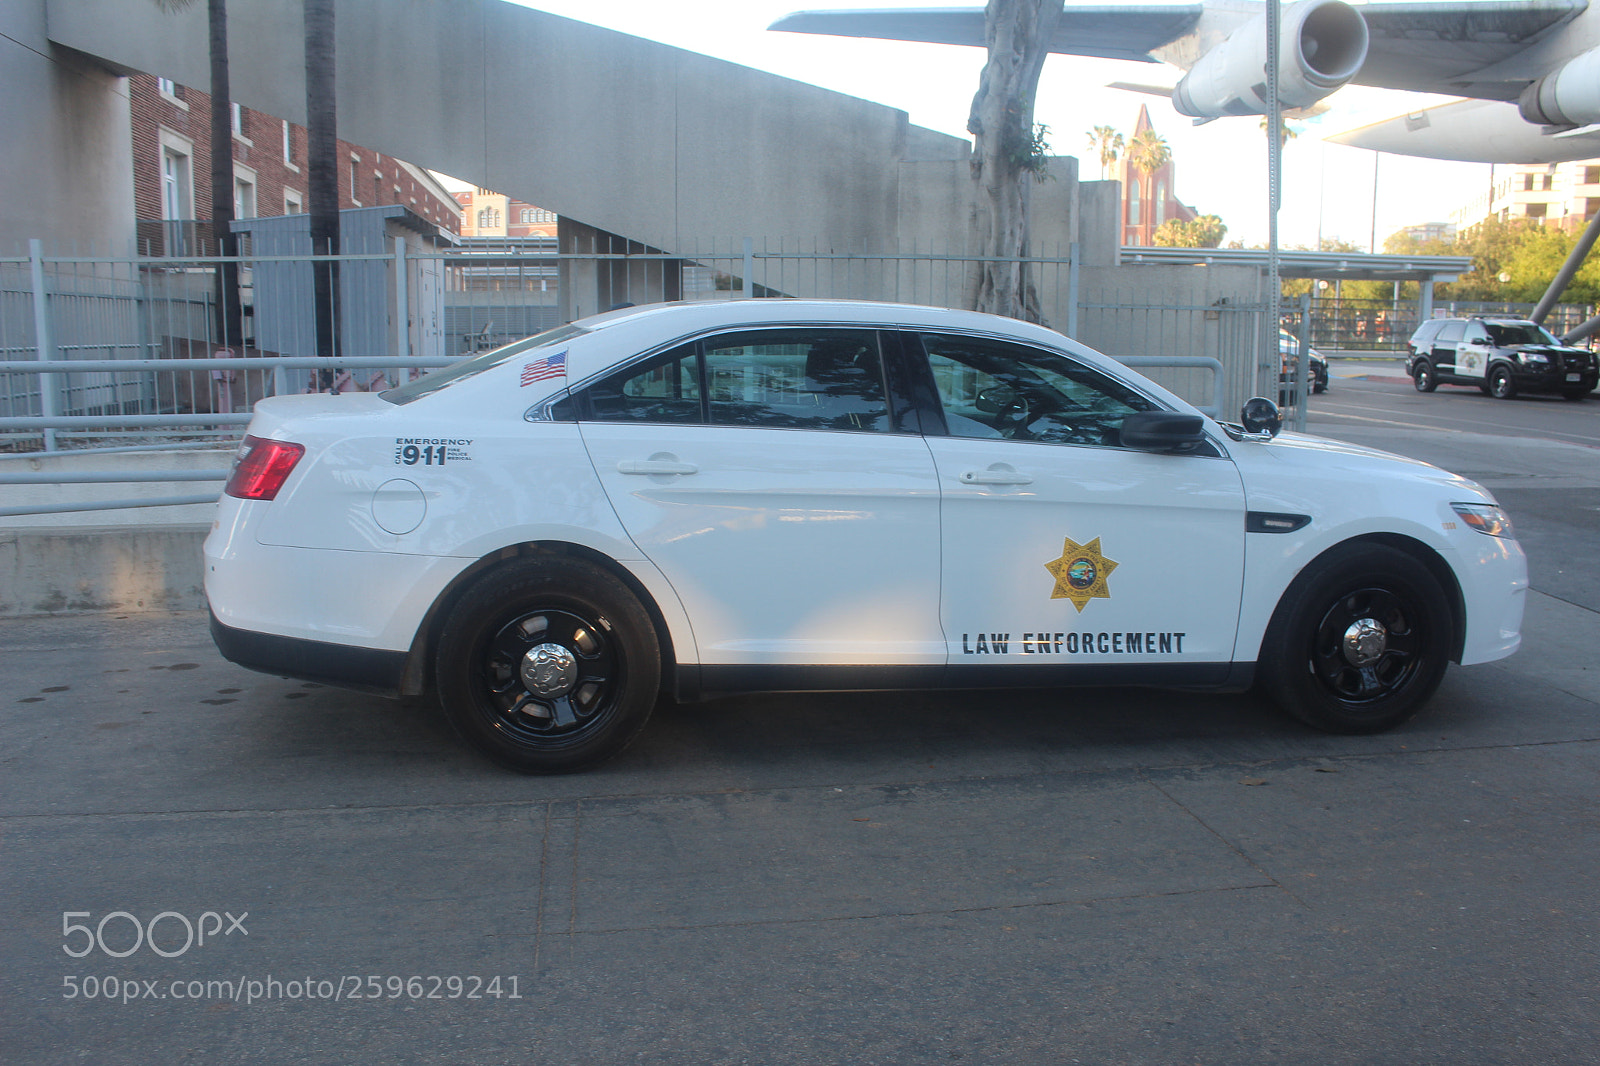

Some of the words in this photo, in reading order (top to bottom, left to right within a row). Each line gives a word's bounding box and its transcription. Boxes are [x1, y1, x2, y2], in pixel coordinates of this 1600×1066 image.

[396, 438, 474, 446] EMERGENCY
[402, 445, 446, 466] 9-1-1
[962, 633, 1010, 654] LAW
[1023, 632, 1186, 654] ENFORCEMENT
